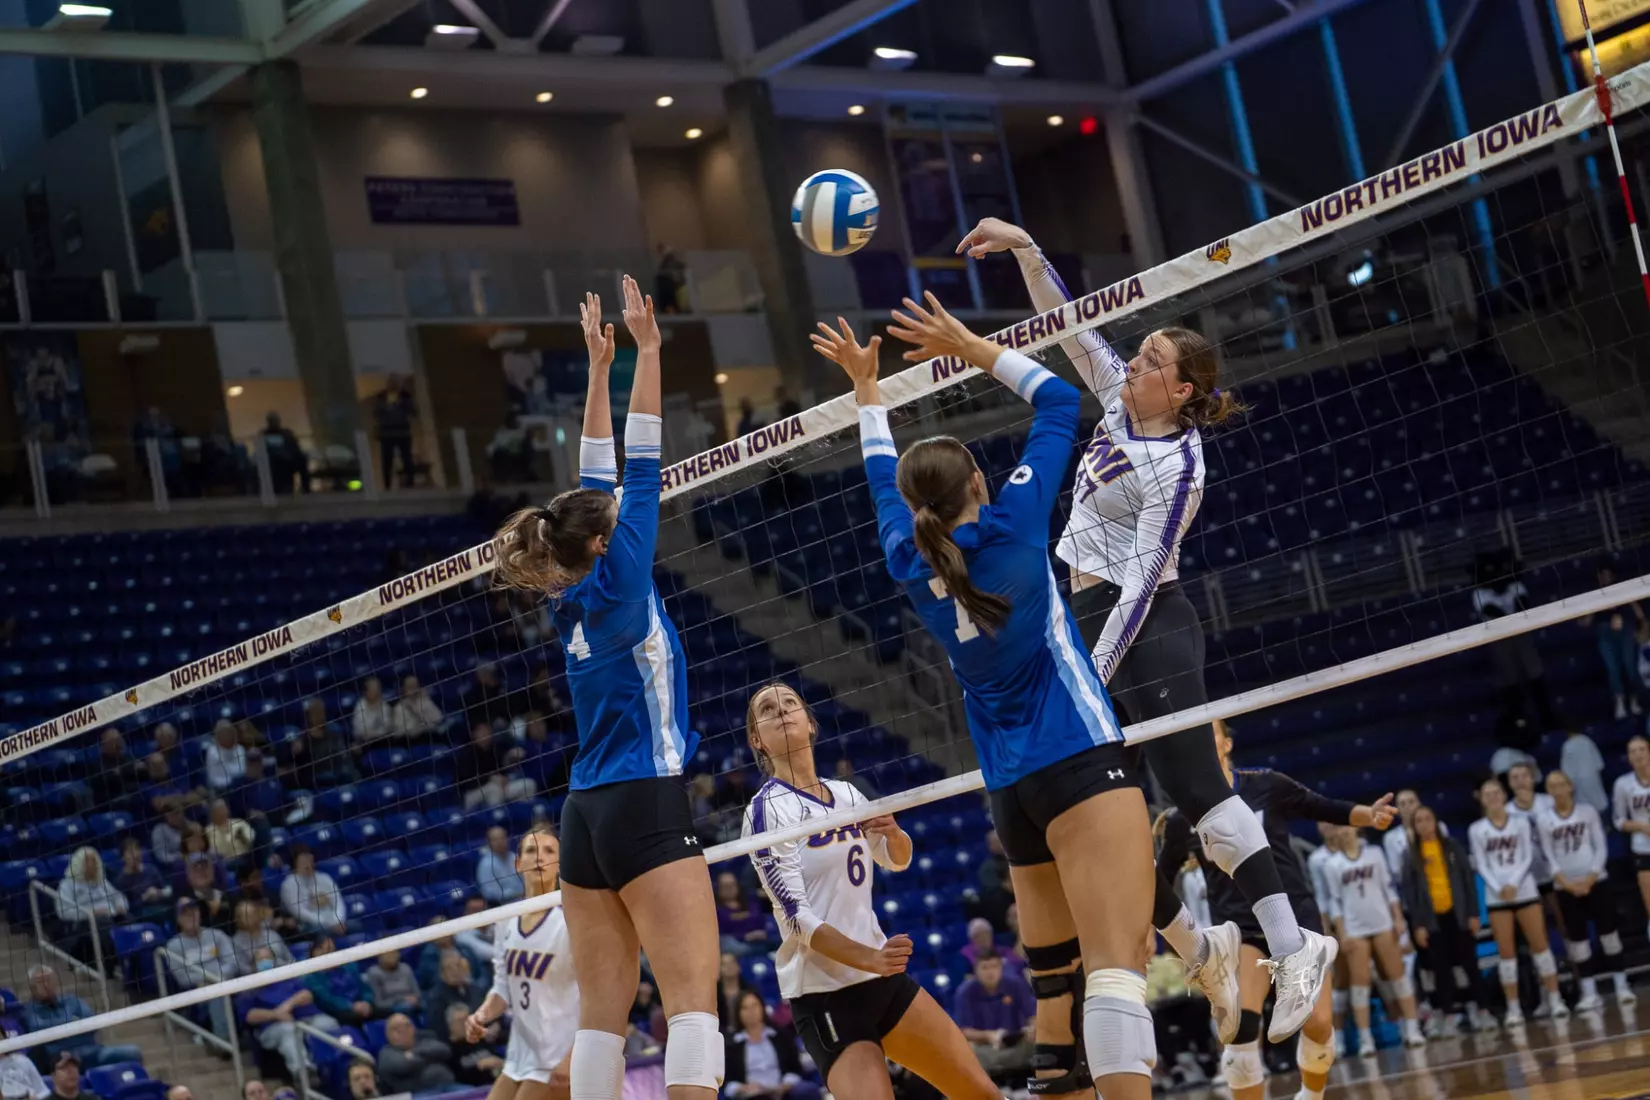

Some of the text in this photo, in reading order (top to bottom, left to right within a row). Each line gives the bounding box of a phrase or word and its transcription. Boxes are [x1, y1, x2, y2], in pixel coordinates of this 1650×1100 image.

[1301, 104, 1564, 233] NORTHERN IOWA
[932, 276, 1145, 384] NOHERN IOWA
[660, 415, 805, 493] RTHERN IOWA
[378, 551, 472, 606] NORTHERN
[169, 626, 293, 691] NORTHERN IOWA
[566, 620, 592, 662] 4
[0, 705, 97, 758] ORTHERN IOWA
[846, 843, 867, 888] 6
[519, 980, 531, 1011] 3
